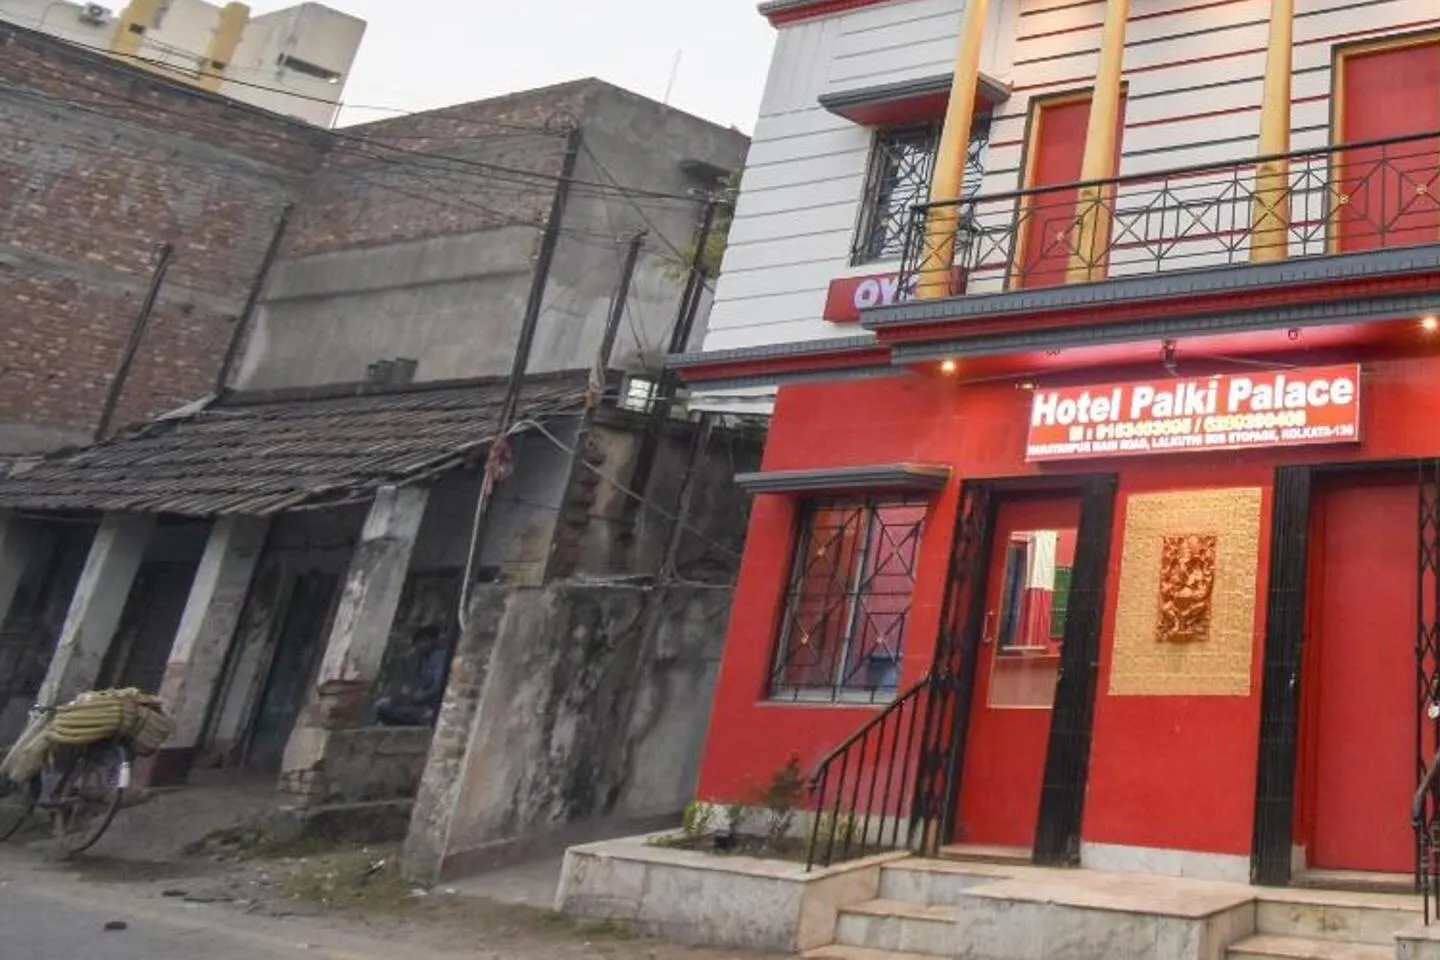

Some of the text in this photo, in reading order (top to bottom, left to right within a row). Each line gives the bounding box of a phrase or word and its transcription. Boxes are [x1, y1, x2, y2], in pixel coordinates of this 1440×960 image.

[854, 275, 919, 309] OY
[1031, 375, 1353, 427] Hotel Palki Palace
